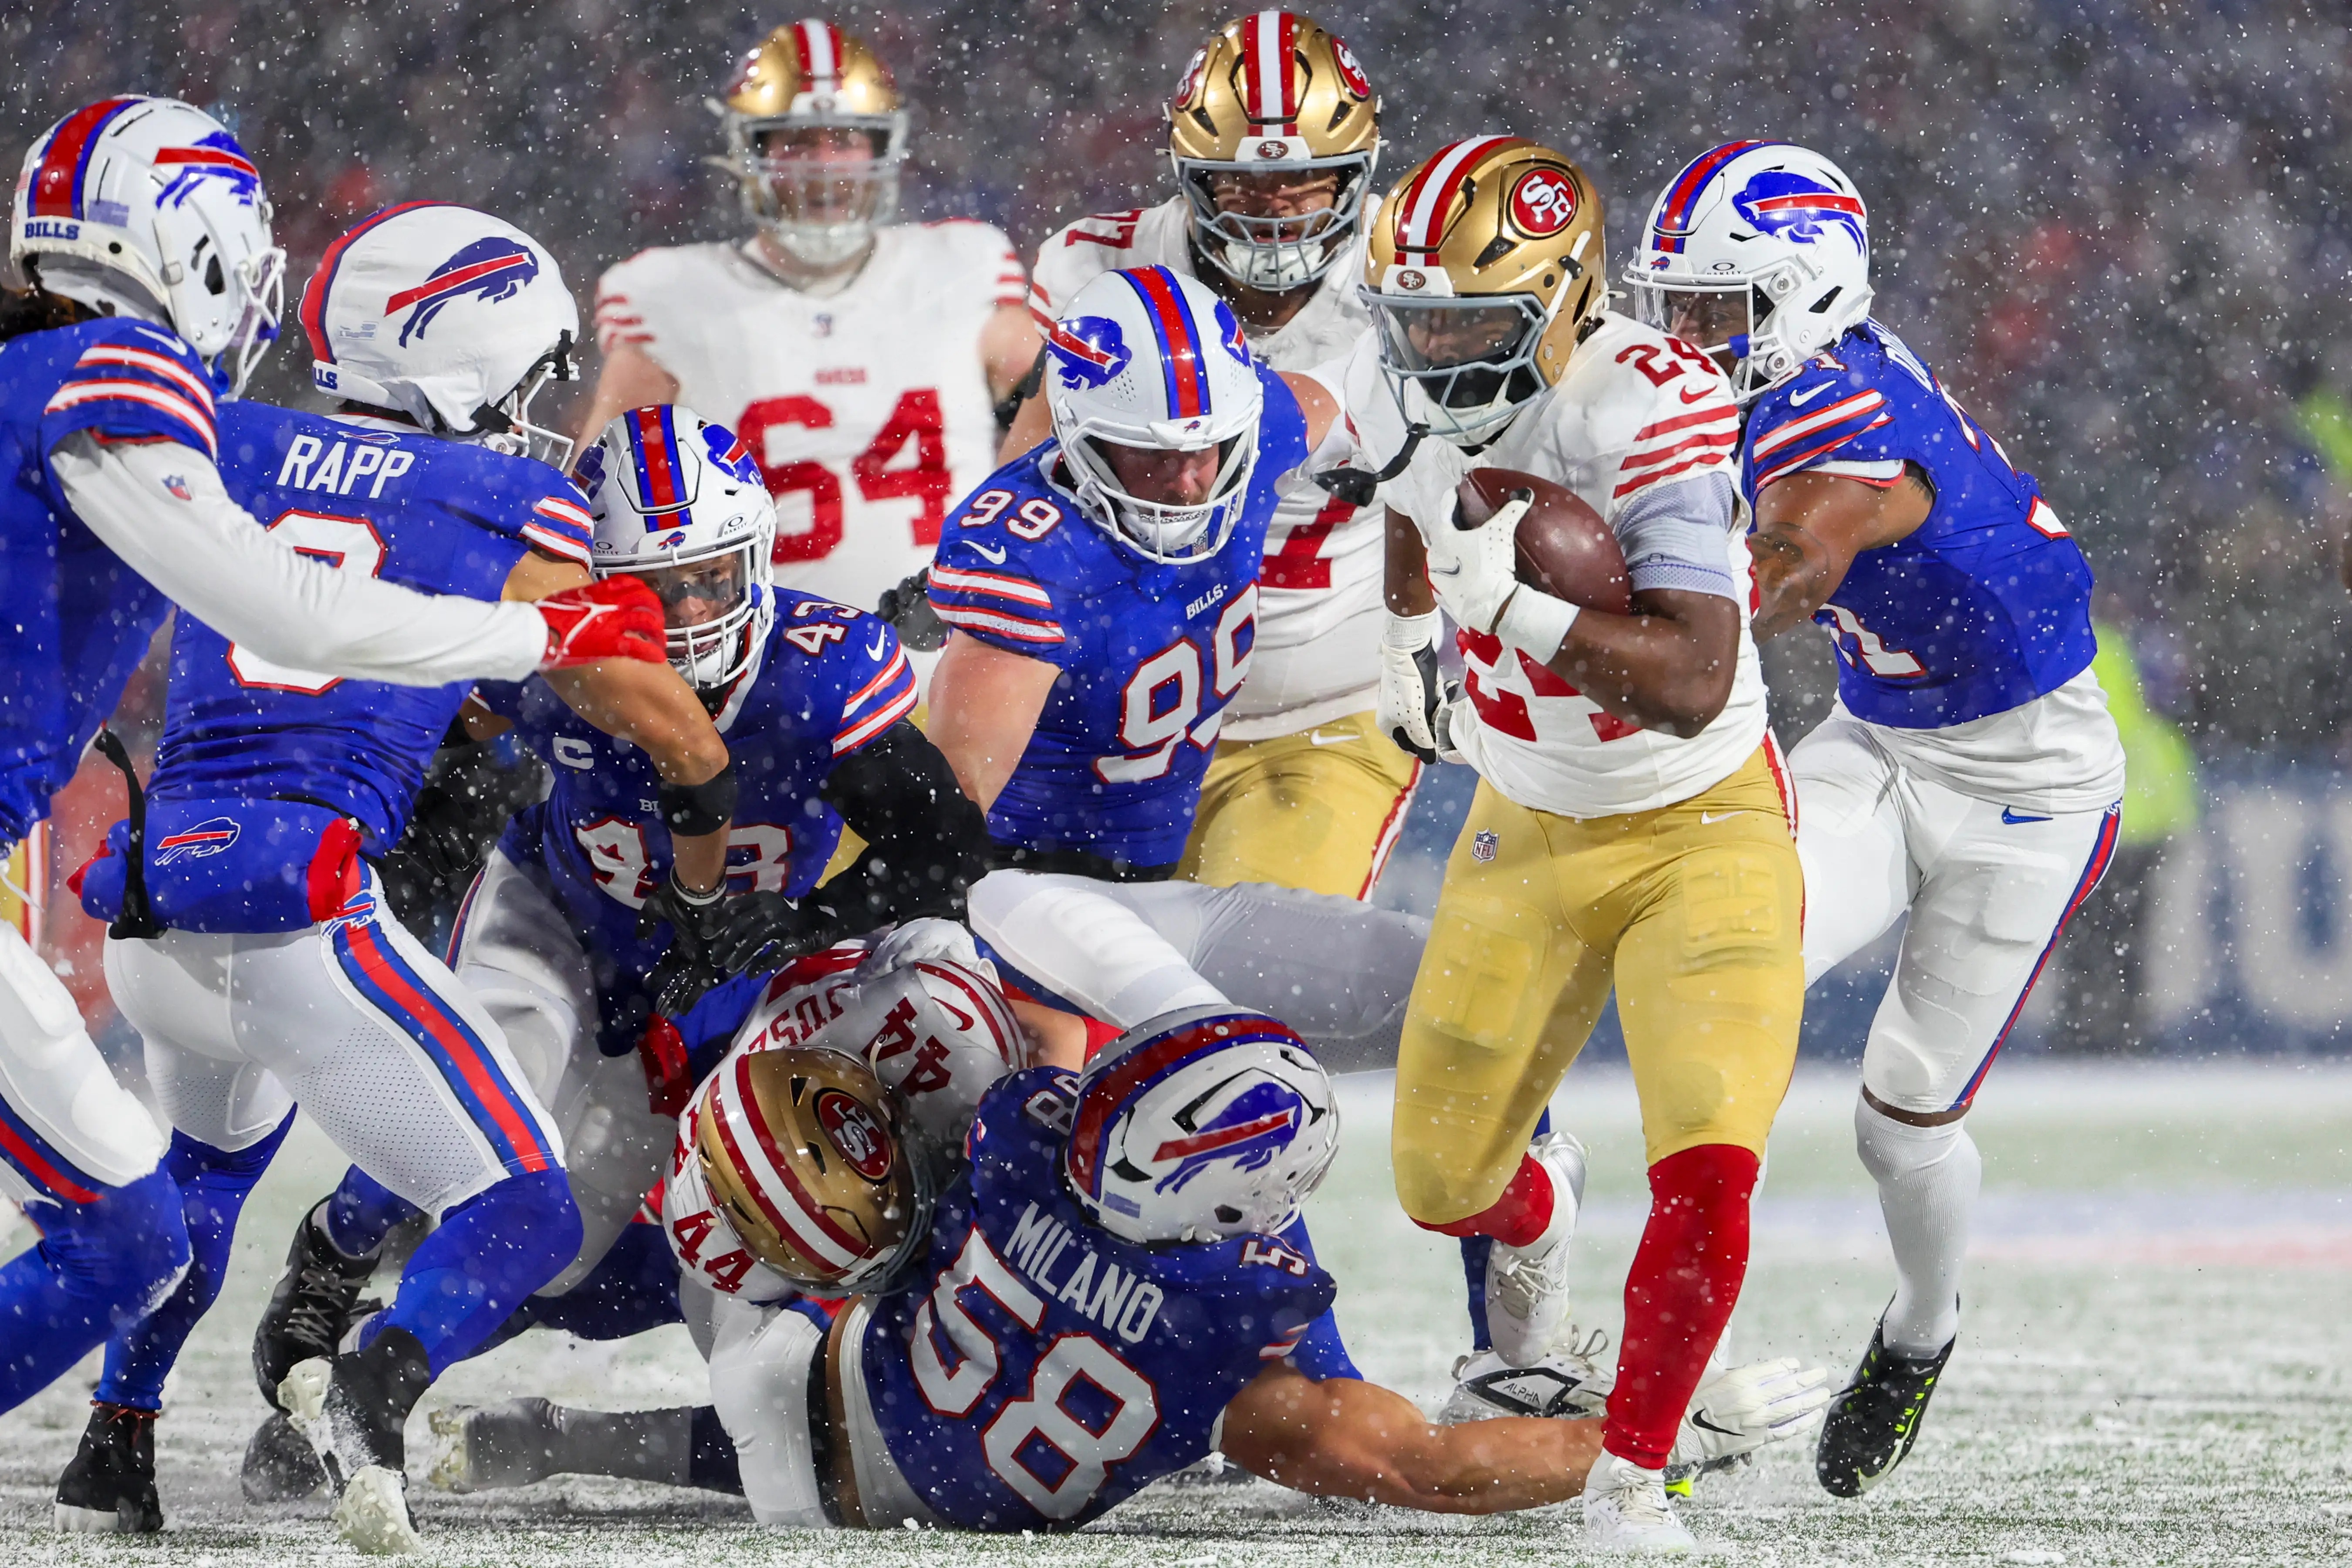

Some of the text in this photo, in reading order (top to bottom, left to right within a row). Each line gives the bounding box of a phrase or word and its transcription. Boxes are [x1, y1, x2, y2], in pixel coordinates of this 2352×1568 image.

[25, 221, 79, 240] BILLS
[1615, 337, 1720, 388] 24
[276, 434, 415, 499] RAPP
[735, 388, 954, 566] 64
[960, 489, 1063, 542] 99
[1186, 583, 1223, 620] BILLS
[1091, 578, 1260, 785] 99
[552, 736, 594, 770] C
[1475, 842, 1491, 857] NFL
[860, 996, 952, 1097] 44
[673, 1209, 756, 1294] 44
[1003, 1201, 1164, 1344] MILANO
[909, 1221, 1163, 1521] 58
[1503, 1382, 1540, 1406] ALPHA
